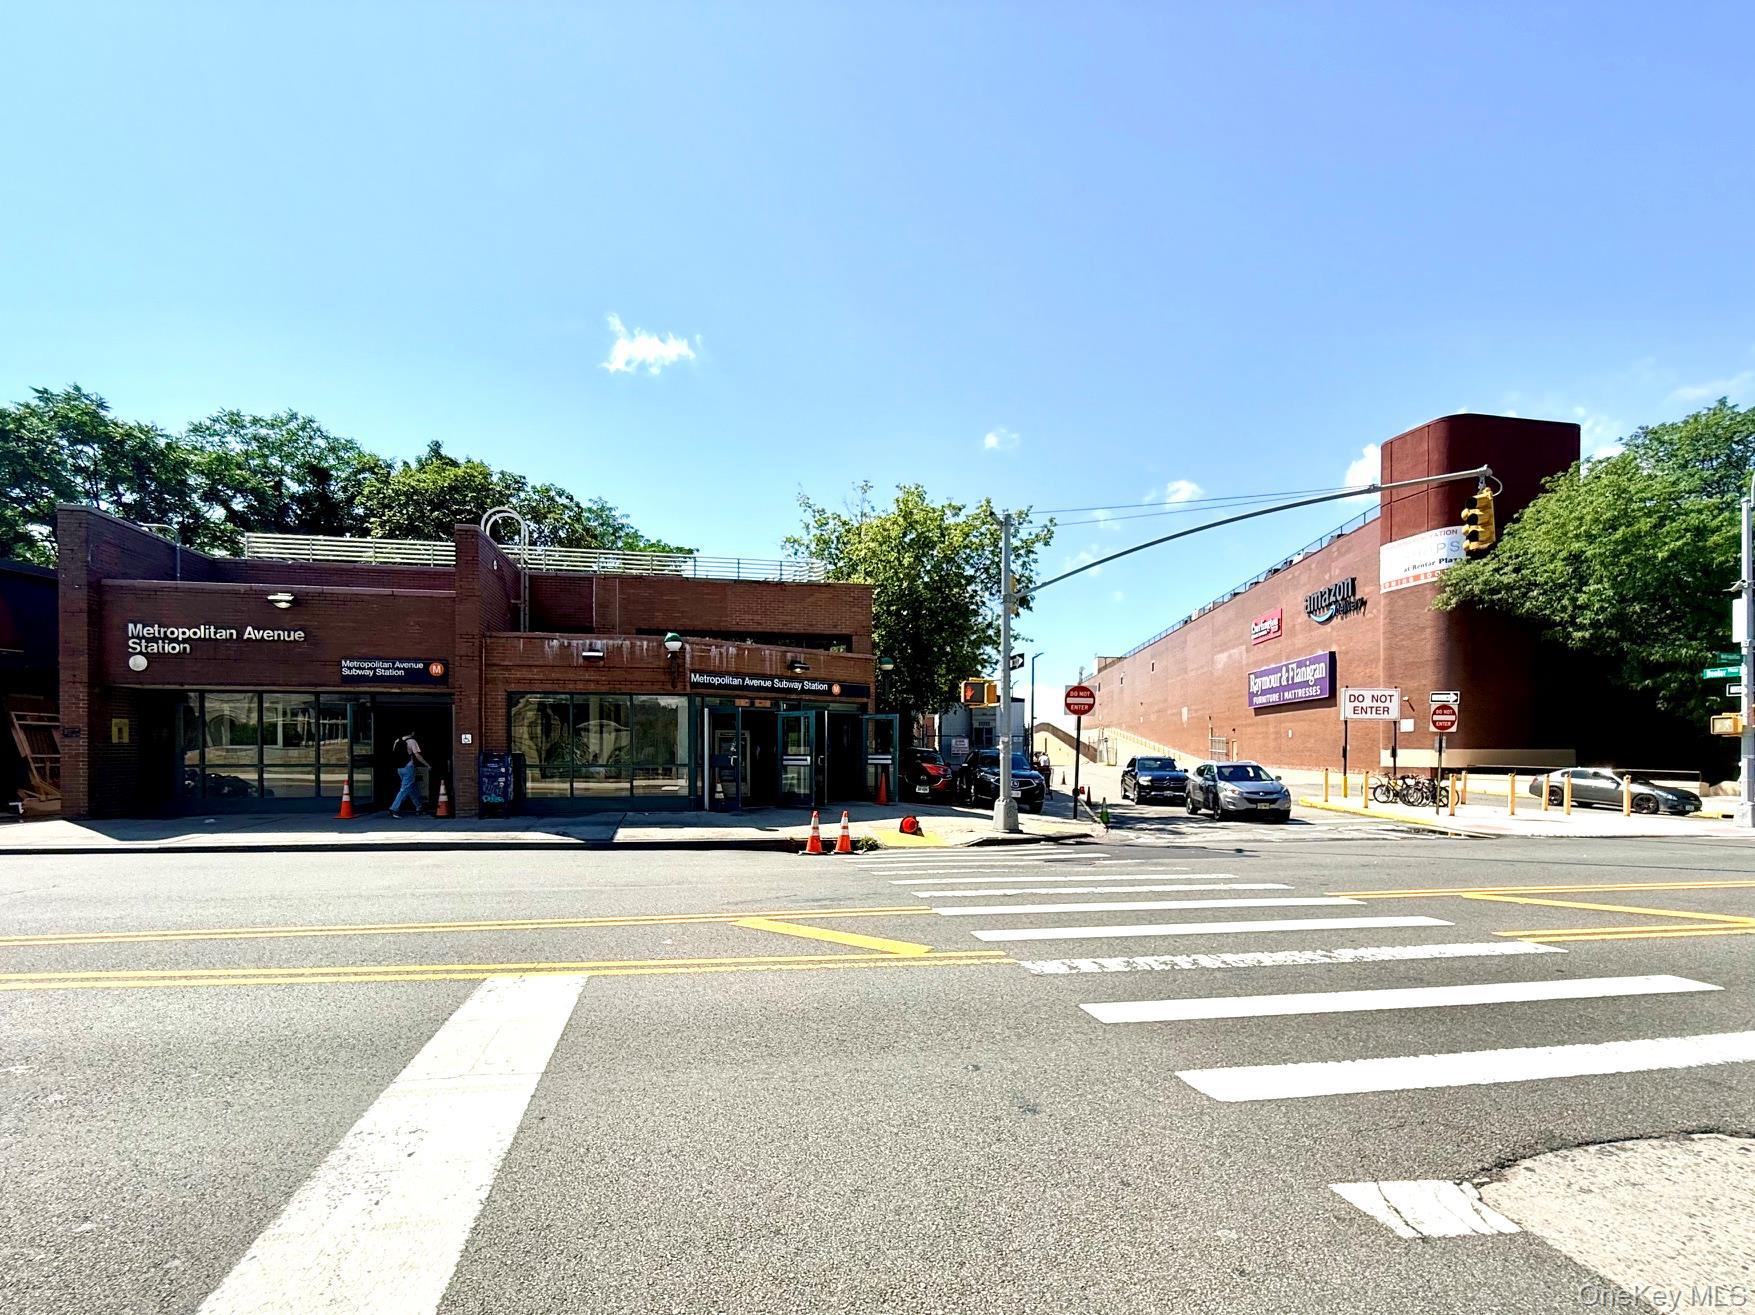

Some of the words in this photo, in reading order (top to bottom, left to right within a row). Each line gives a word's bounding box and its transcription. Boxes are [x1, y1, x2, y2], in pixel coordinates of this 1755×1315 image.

[1412, 561, 1436, 571] Rentar
[1304, 578, 1352, 612] amazon
[128, 622, 237, 642] Metropolitan
[244, 625, 305, 641] Avenue
[128, 638, 191, 654] Station
[341, 659, 393, 671] Metropolitan
[394, 660, 424, 670] Avenue
[341, 667, 373, 678] Subway
[376, 668, 405, 677] Station
[691, 673, 743, 686] Metropolitan
[744, 676, 772, 688] Avenue
[774, 679, 802, 691] Subway
[804, 681, 828, 691] Station
[1249, 672, 1281, 695] Raymour
[1281, 666, 1288, 686] &
[1289, 661, 1326, 686] Flanigan
[1253, 692, 1280, 705] FURNITURE
[1284, 686, 1321, 700] MATTRESSES
[1348, 694, 1365, 704] DO
[1371, 694, 1395, 704] NOT
[1353, 706, 1390, 716] ENTER
